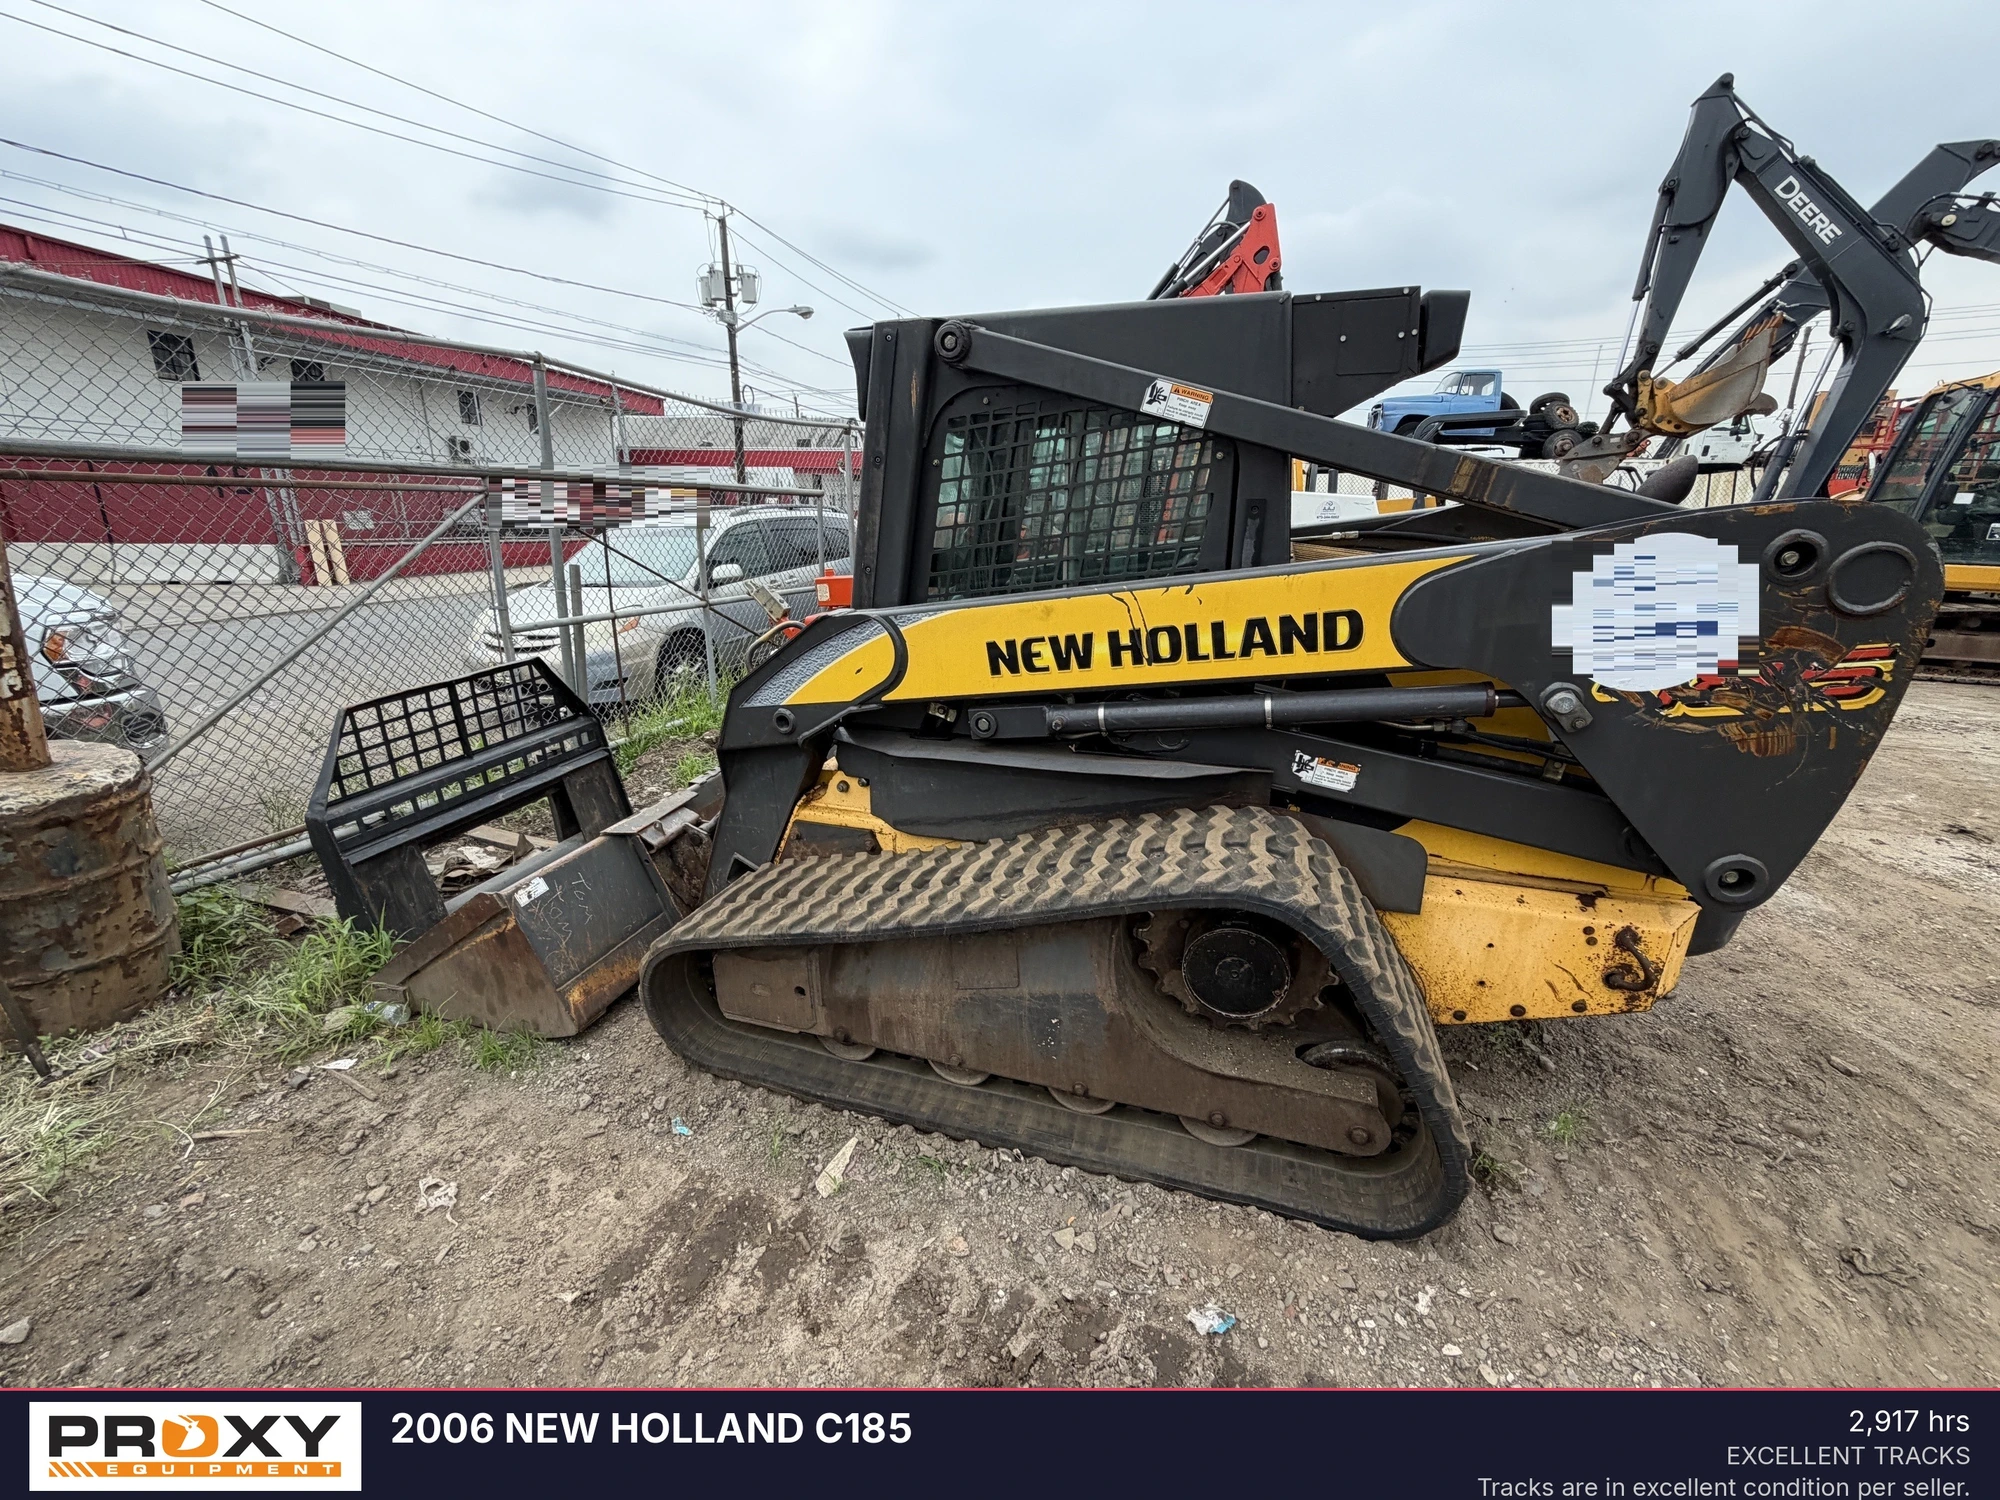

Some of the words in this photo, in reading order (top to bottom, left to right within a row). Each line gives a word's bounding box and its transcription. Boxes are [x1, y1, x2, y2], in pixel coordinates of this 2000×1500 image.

[1774, 175, 1843, 245] DEERE
[1181, 388, 1209, 401] WARNING
[985, 631, 1095, 677] NEW
[1107, 608, 1366, 668] HOLLAND
